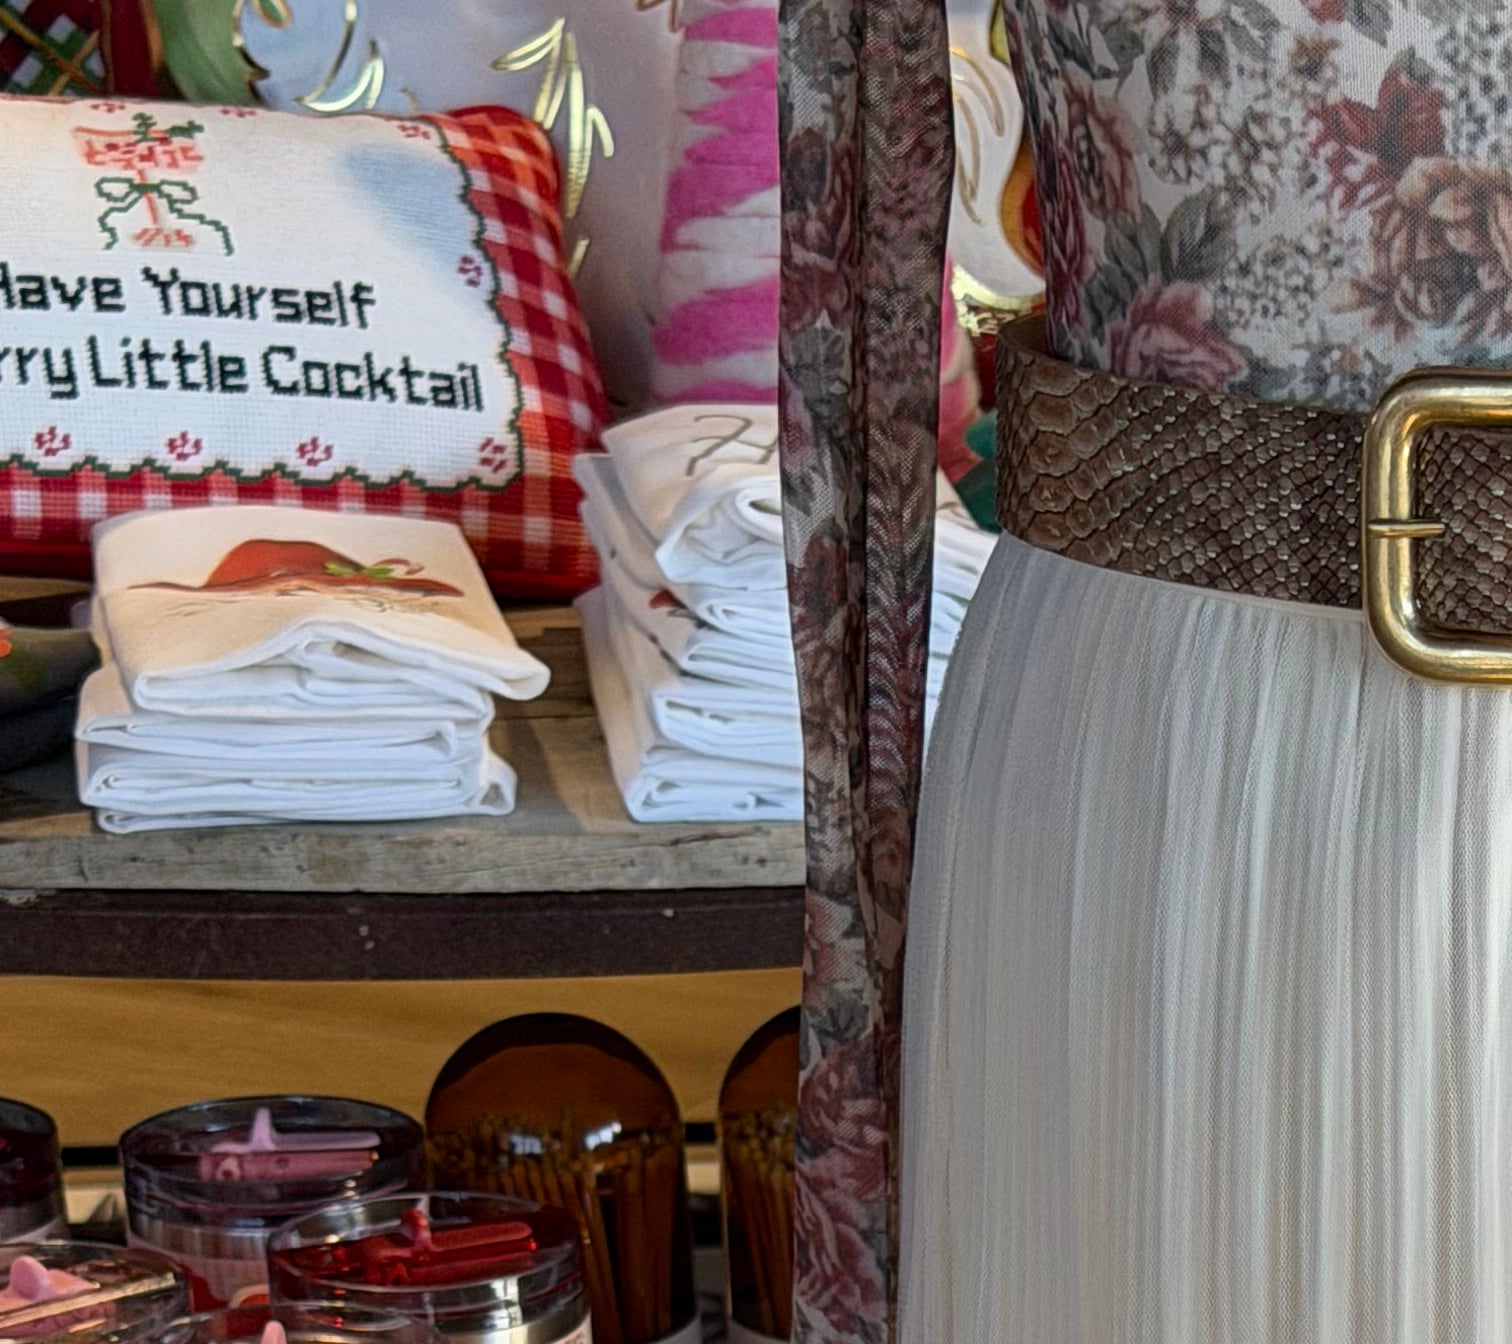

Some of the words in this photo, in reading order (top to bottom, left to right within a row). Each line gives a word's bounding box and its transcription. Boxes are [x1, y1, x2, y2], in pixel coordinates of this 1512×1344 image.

[140, 266, 376, 329] Yourself
[88, 335, 249, 394] Little
[262, 345, 484, 412] Cocktail
